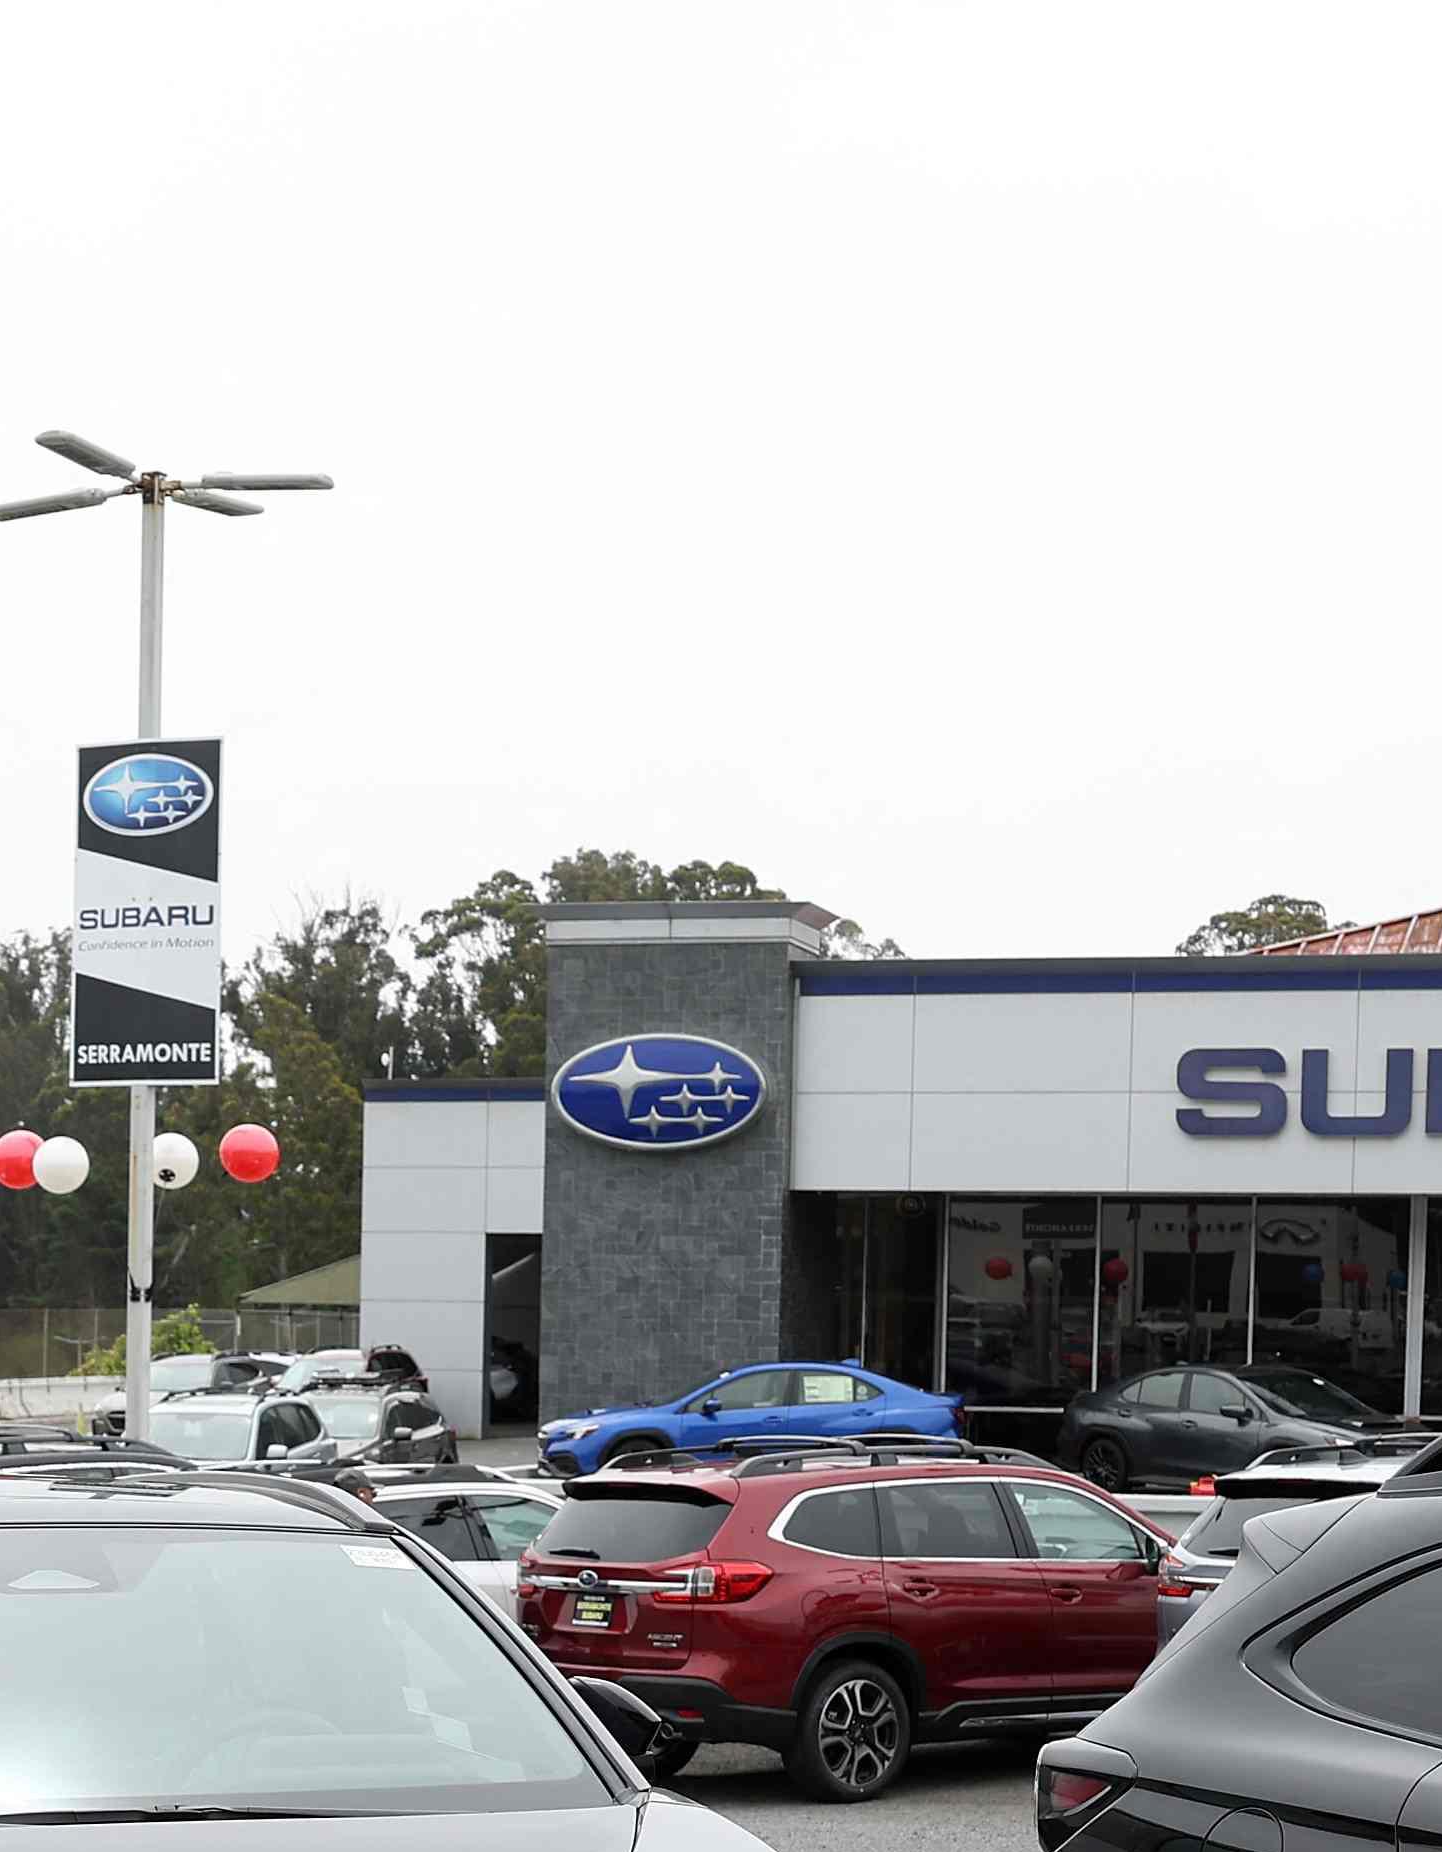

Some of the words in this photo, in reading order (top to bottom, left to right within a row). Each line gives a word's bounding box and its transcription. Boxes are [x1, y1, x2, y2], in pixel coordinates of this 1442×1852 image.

[79, 904, 214, 930] SUBARU
[78, 939, 148, 952] Confidence
[151, 938, 163, 948] in
[166, 936, 214, 949] Motion
[77, 1042, 212, 1065] SERRAMONTE
